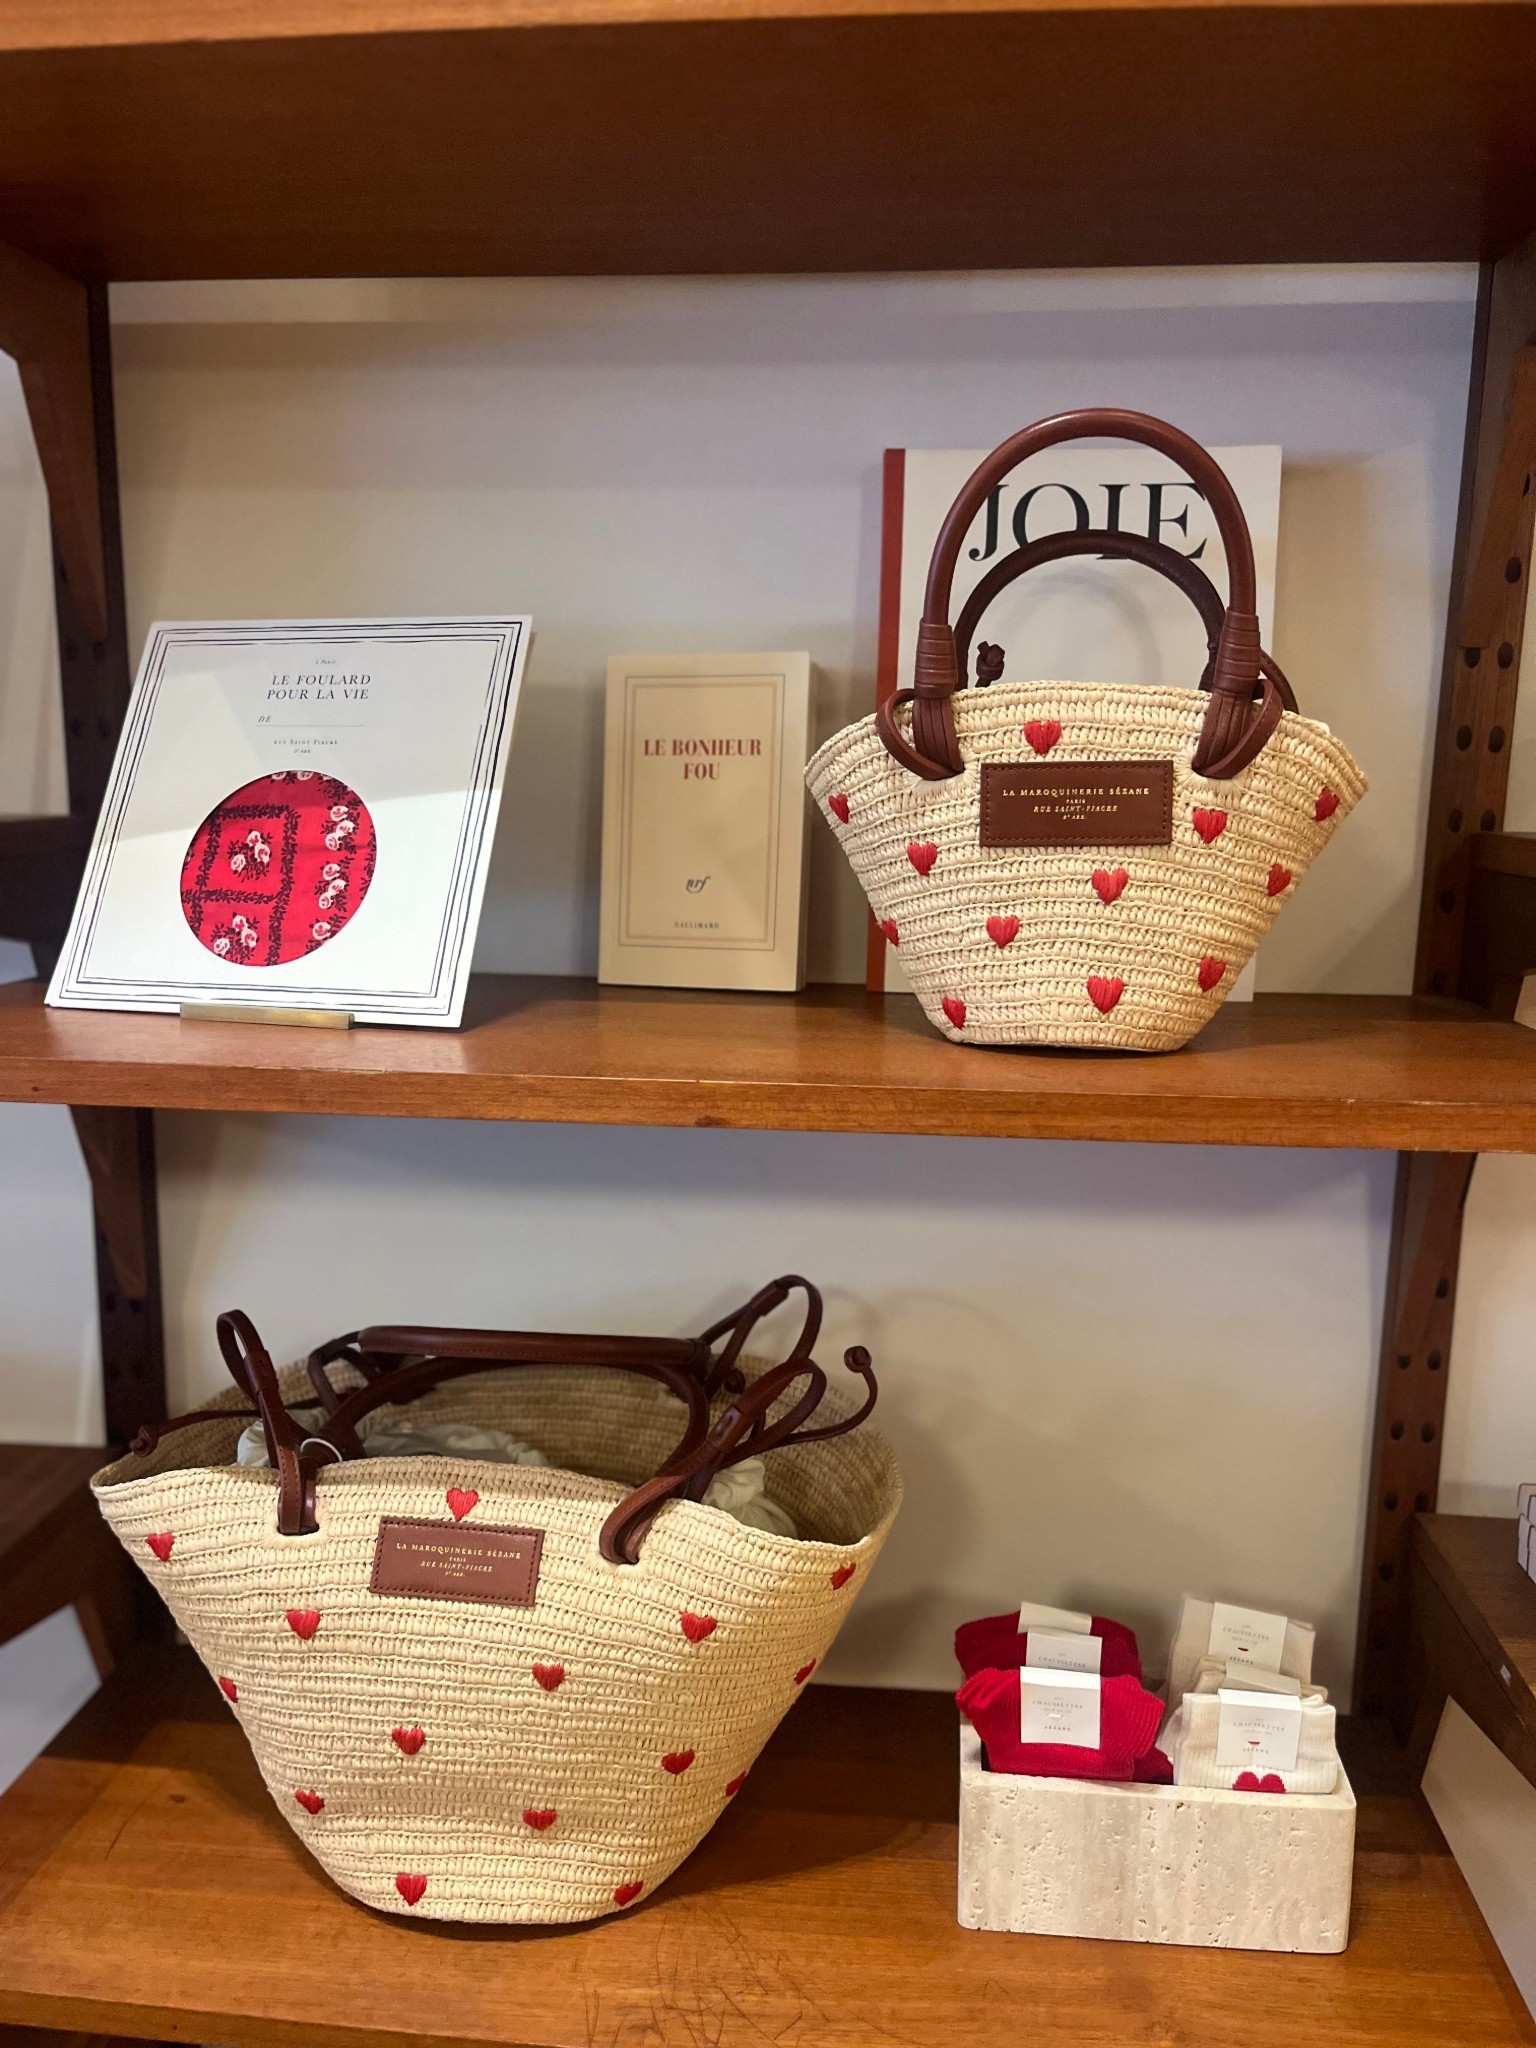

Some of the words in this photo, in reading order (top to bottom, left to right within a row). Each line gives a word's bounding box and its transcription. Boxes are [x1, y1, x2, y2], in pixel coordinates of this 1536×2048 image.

[968, 483, 1208, 562] JOIE
[272, 675, 290, 686] LE
[296, 674, 371, 686] FOULARD
[267, 689, 309, 700] POUR
[316, 689, 335, 700] LA
[343, 689, 369, 700] VIE
[258, 715, 272, 723] DE
[643, 739, 666, 756] LE
[672, 739, 762, 756] BONHEUR
[684, 762, 720, 780] FOU
[1020, 788, 1104, 797] MAROQUINERIE
[1109, 786, 1150, 796] SÉZANE
[685, 875, 711, 894] nrf
[673, 920, 720, 929] GALLIMARD
[396, 1542, 407, 1550] LA
[411, 1543, 483, 1556] MAROQUINERIE
[487, 1549, 521, 1560] SÉZANE
[420, 1560, 436, 1568] RUE
